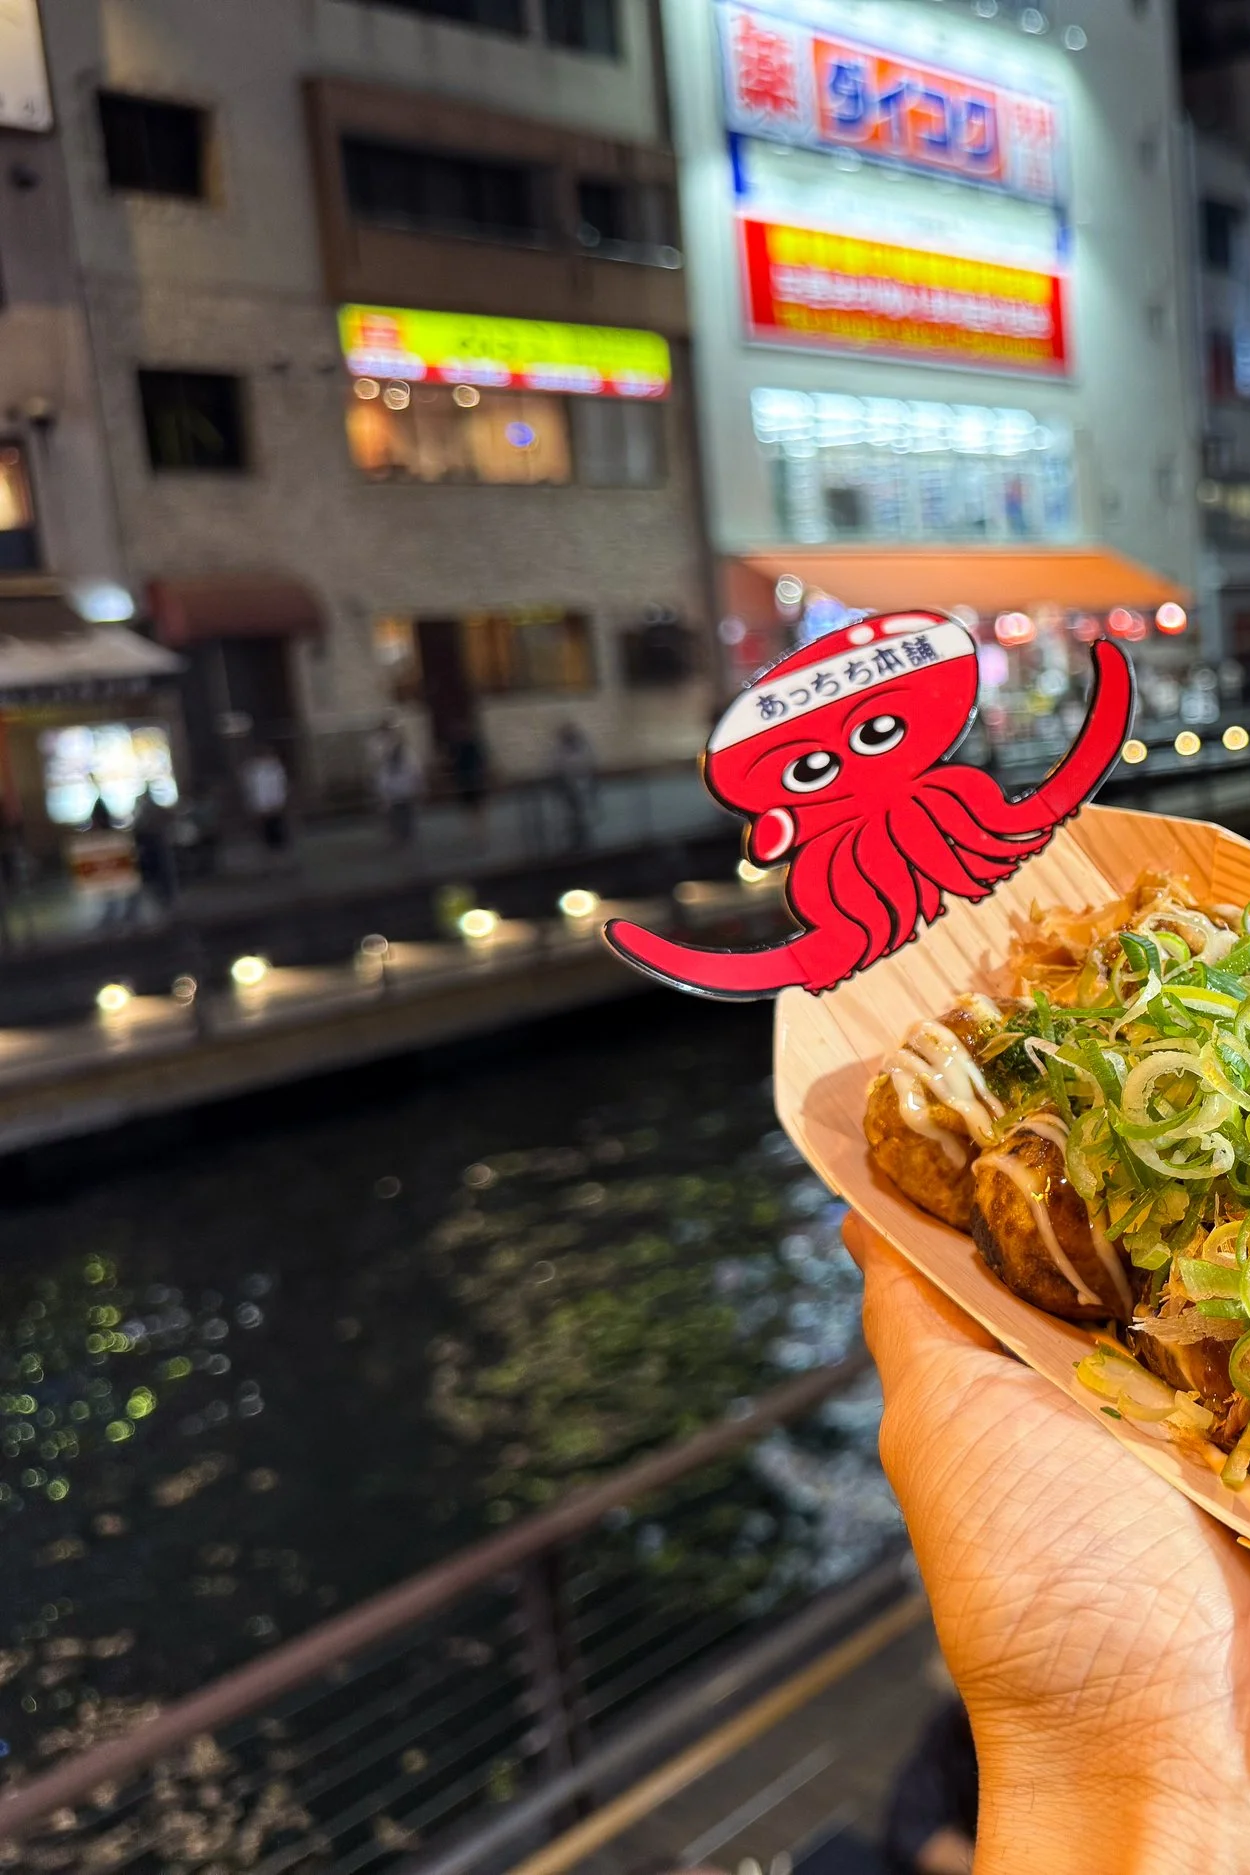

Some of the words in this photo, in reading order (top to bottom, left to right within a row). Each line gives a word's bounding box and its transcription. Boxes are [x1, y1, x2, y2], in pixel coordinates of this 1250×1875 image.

[756, 635, 941, 720] あっちち本舗
